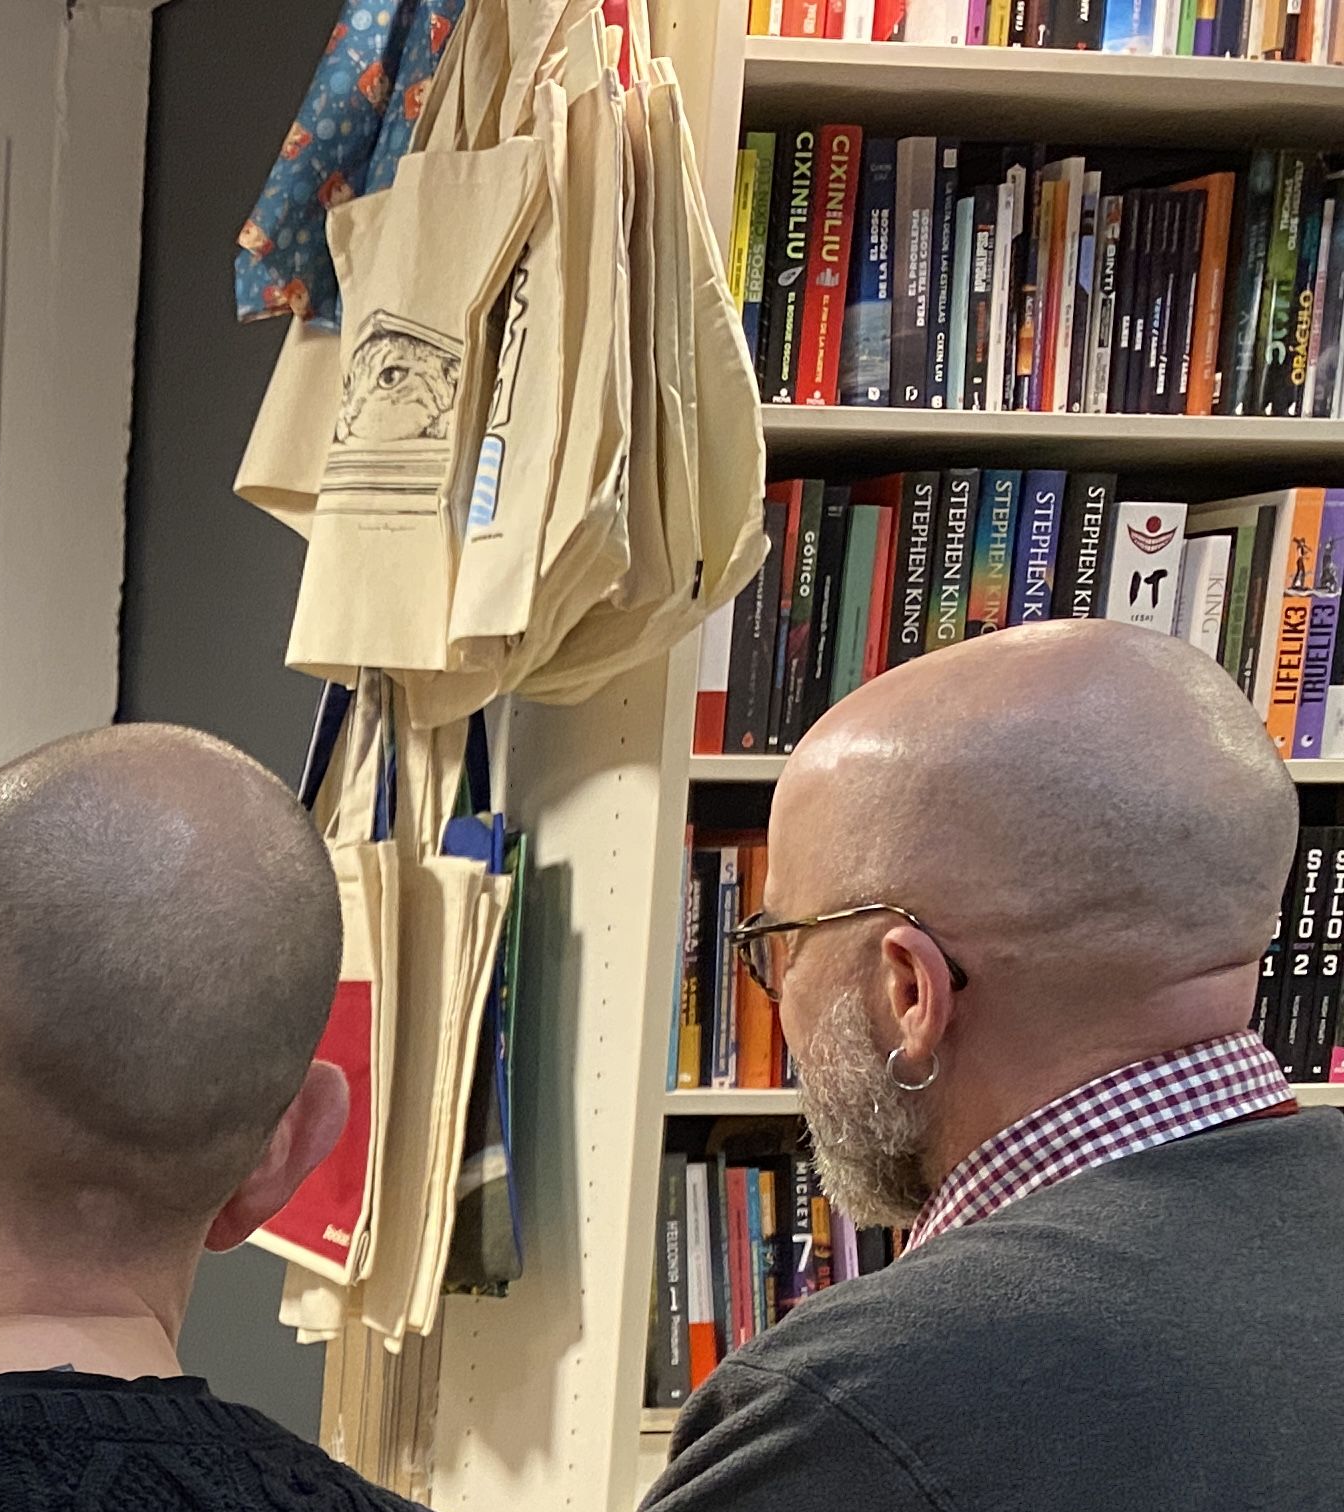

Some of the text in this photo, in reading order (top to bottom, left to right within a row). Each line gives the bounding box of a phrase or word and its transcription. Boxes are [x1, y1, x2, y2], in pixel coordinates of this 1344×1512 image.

[786, 131, 814, 259] CIXIN LIU
[821, 135, 850, 262] CIXIN LIU
[869, 208, 880, 261] EL BOSC
[878, 208, 890, 299] DE LA FOSCOR
[908, 208, 920, 297] EL PROBLEMA
[918, 262, 928, 294] TRES
[781, 292, 795, 381] EL BOSQUE OSCURO
[916, 296, 927, 327] DELS
[938, 273, 949, 324] ESTRELLAS
[1289, 289, 1314, 386] ORÁCULO
[798, 531, 815, 597] GÓTICO
[901, 484, 933, 644] STEPHEN KING
[937, 480, 970, 640] STEPHEN KING
[988, 480, 1013, 580] STEPHEN
[1025, 491, 1056, 597] STEPHEN
[1076, 486, 1106, 585] STEPHEN
[1129, 569, 1169, 609] IT
[1201, 577, 1225, 634] KING
[1293, 848, 1323, 976] SILO 2
[1262, 955, 1275, 977] 1
[1322, 954, 1339, 976] 3
[792, 1160, 813, 1274] MICKEY 7
